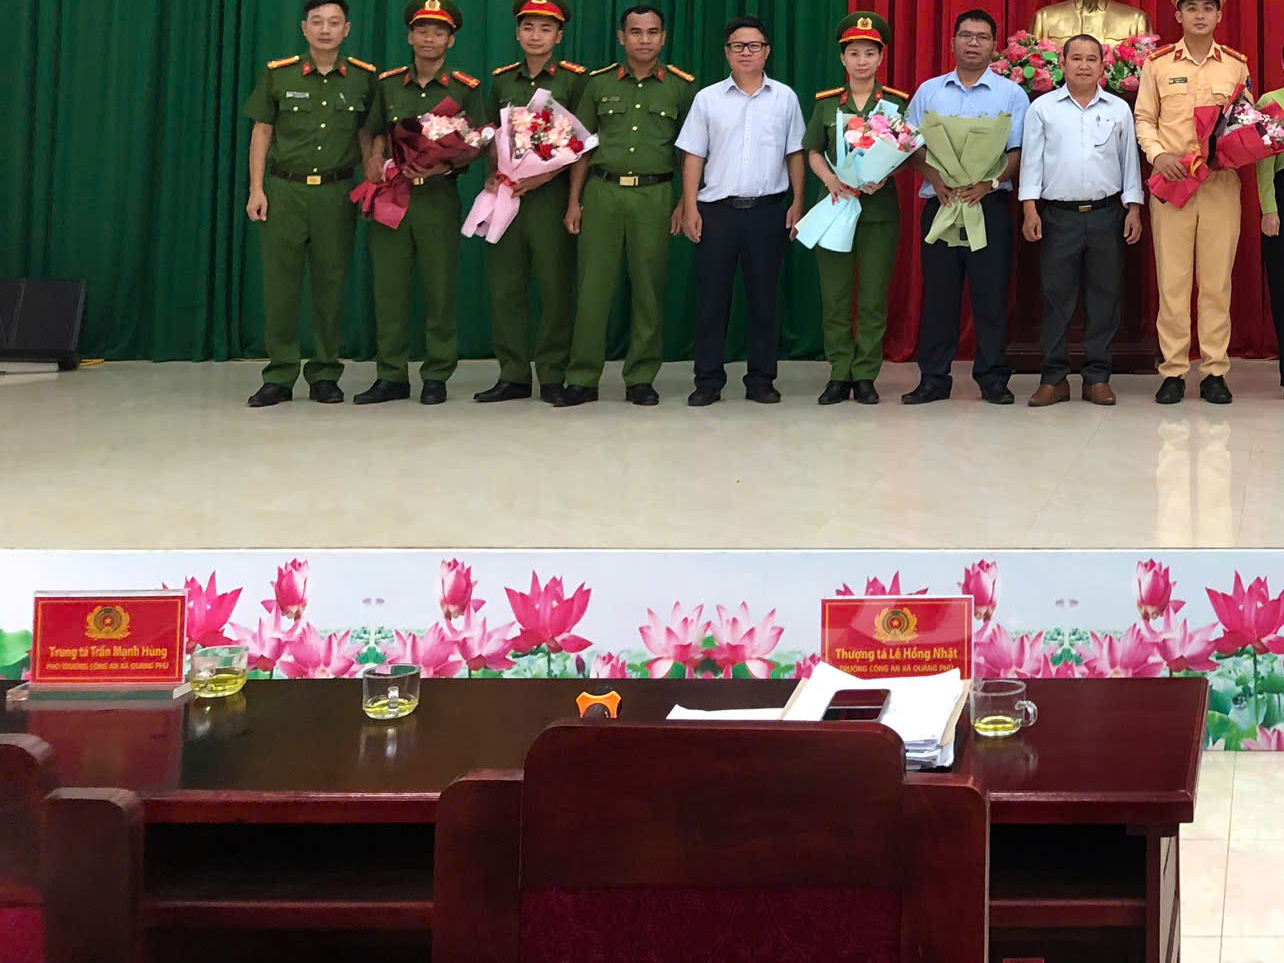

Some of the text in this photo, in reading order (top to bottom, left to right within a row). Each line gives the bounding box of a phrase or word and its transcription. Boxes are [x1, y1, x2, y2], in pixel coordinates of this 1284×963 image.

[836, 648, 874, 662] Thượng
[876, 648, 887, 659] tá
[889, 648, 901, 659] Lê
